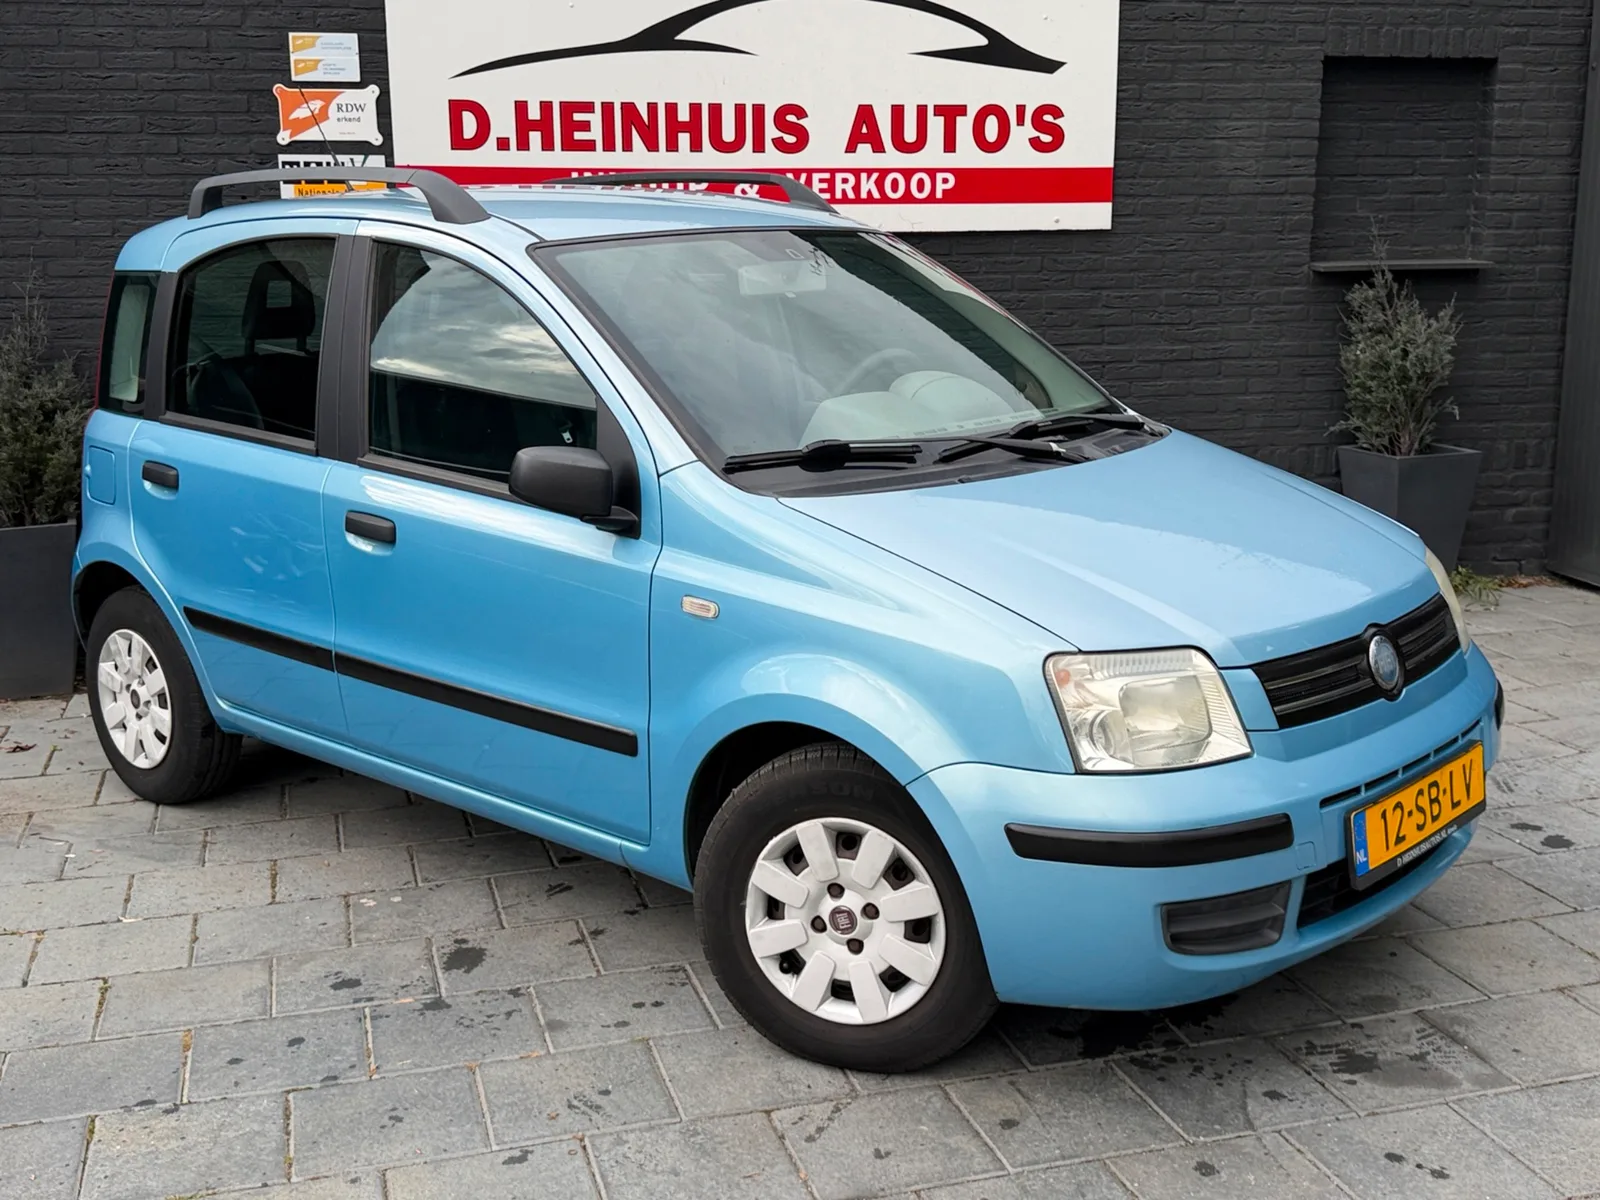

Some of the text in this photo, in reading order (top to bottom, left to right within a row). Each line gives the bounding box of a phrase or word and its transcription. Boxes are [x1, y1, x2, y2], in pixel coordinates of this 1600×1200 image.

[336, 103, 367, 113] RDW
[448, 98, 1065, 154] D.HEINHUIS AUTO'S
[1381, 758, 1473, 852] 12-SB-LV
[1356, 849, 1367, 865] NL
